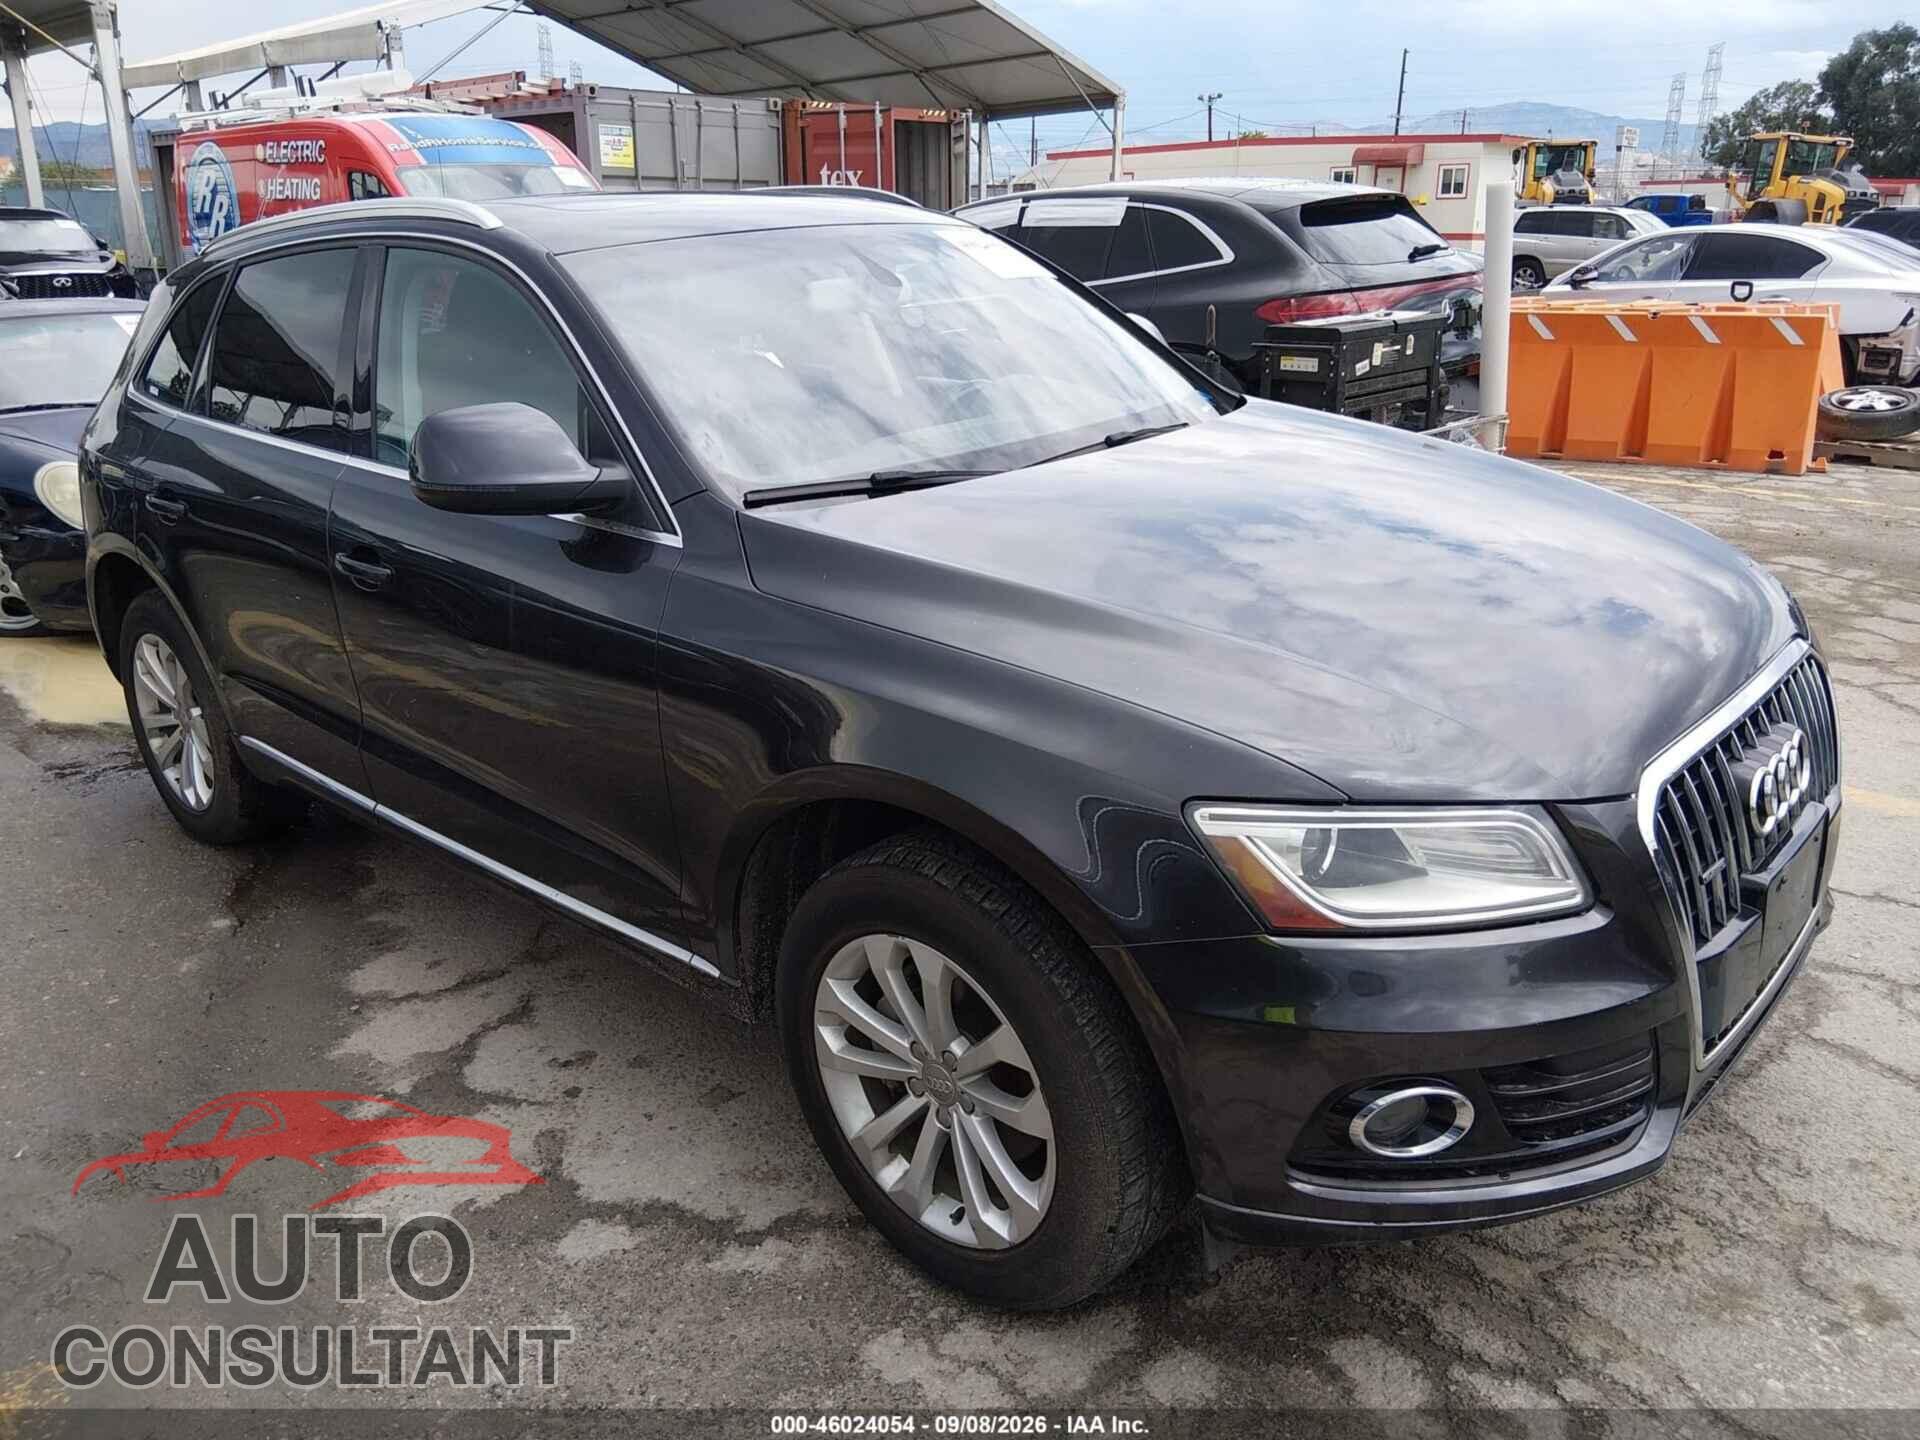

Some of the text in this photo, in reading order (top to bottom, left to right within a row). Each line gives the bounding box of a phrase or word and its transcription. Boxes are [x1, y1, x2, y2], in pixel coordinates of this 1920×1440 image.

[266, 139, 326, 164] ELECTRIC
[819, 161, 863, 187] tex
[266, 177, 321, 200] HEATING
